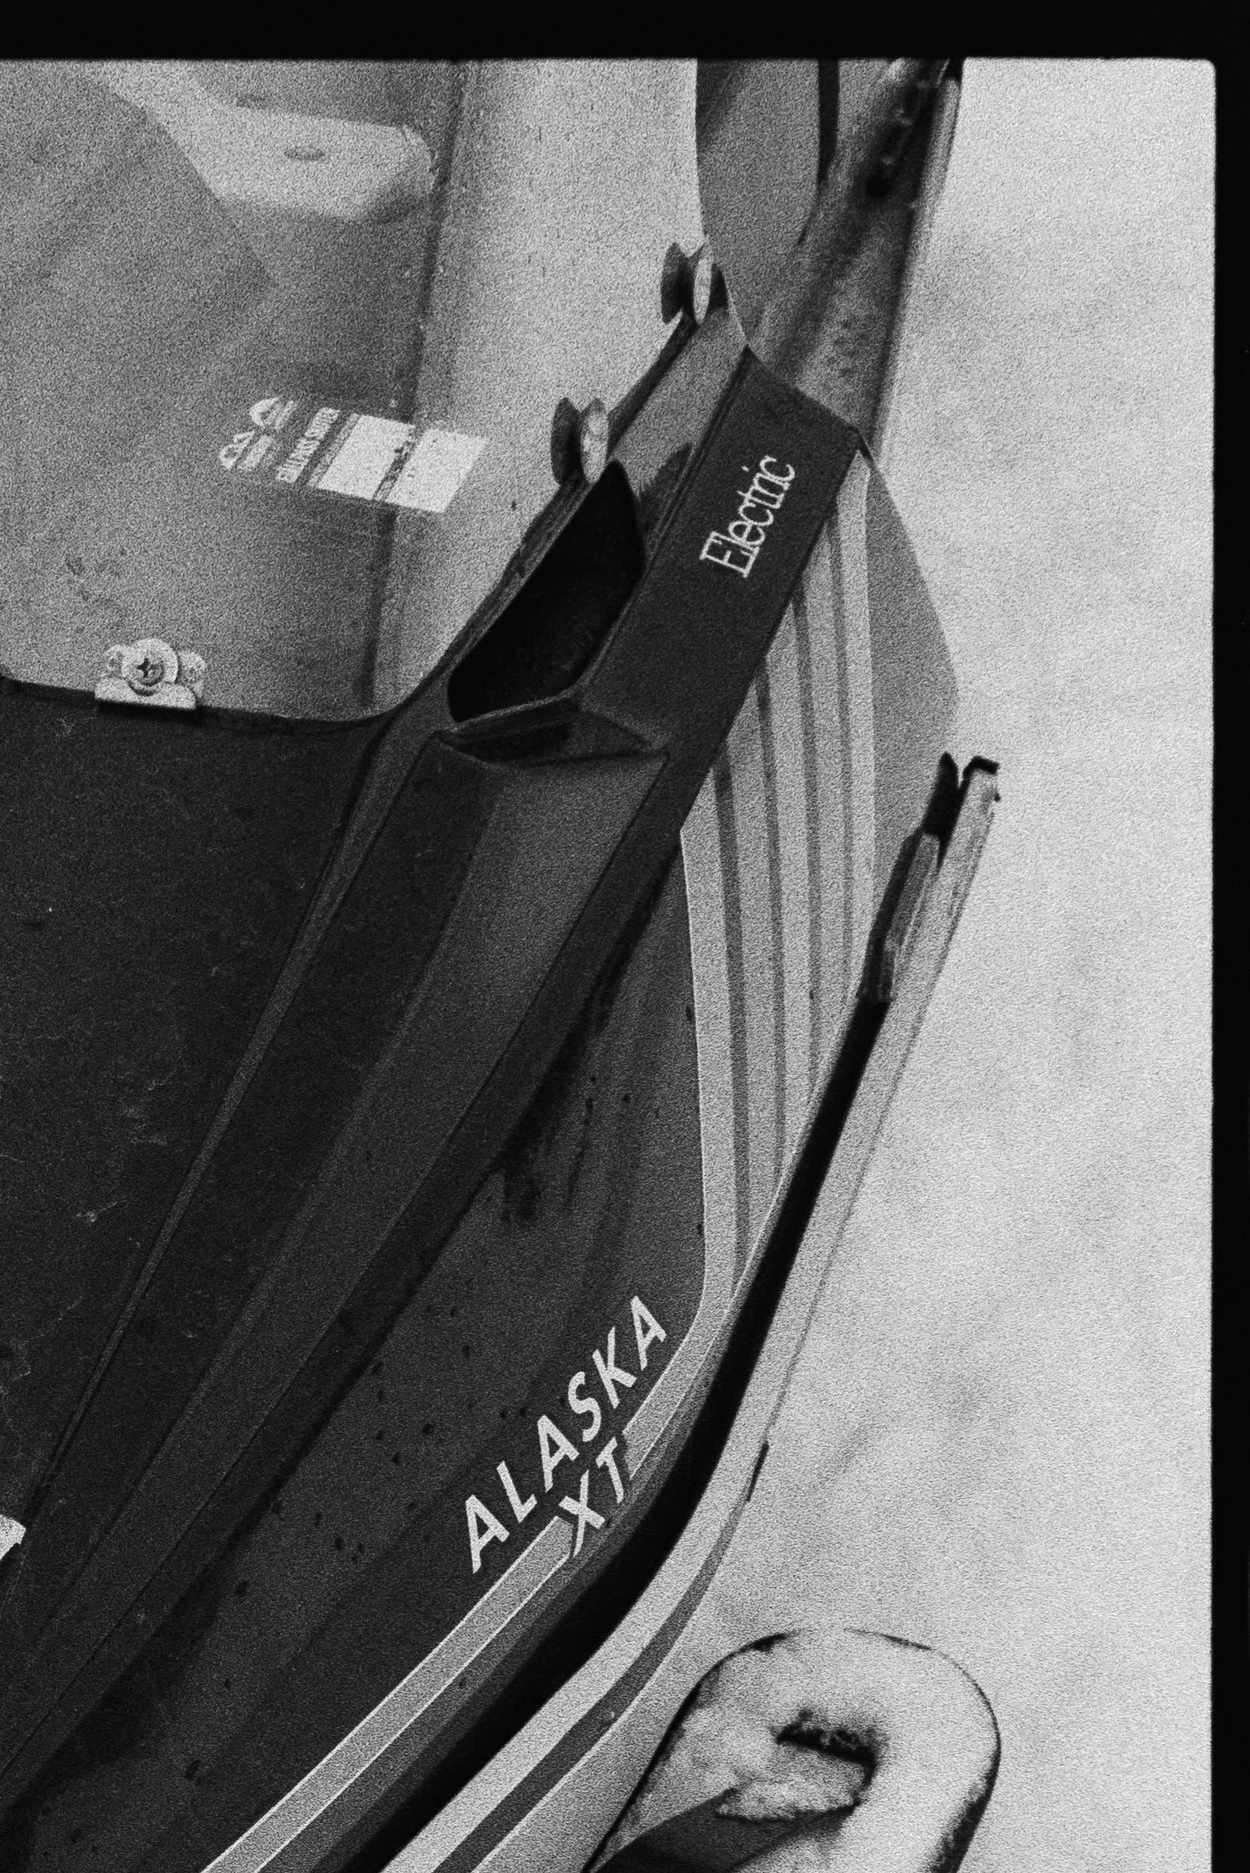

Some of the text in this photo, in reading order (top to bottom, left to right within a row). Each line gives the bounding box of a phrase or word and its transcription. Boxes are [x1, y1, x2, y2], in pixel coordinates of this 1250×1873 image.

[700, 455, 795, 578] Electric
[465, 1295, 667, 1574] ALASKA
[558, 1437, 626, 1558] XT
